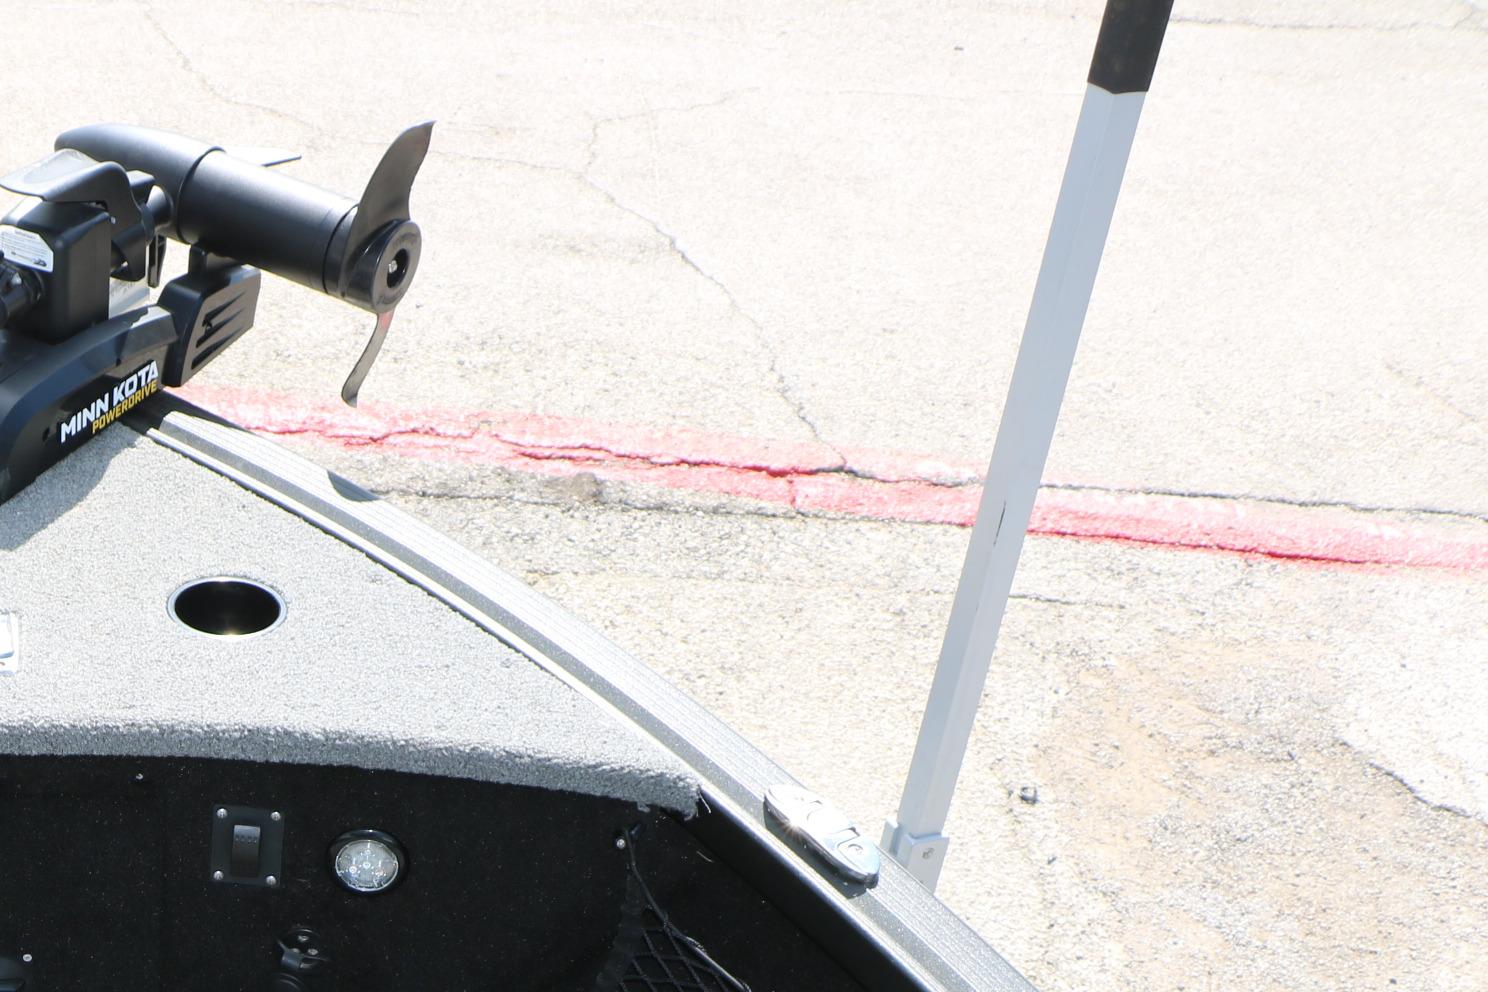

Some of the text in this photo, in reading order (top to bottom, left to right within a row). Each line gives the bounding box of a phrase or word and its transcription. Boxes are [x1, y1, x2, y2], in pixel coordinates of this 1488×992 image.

[60, 360, 159, 444] MINN KOTA
[92, 380, 158, 434] POWERDRIVE
